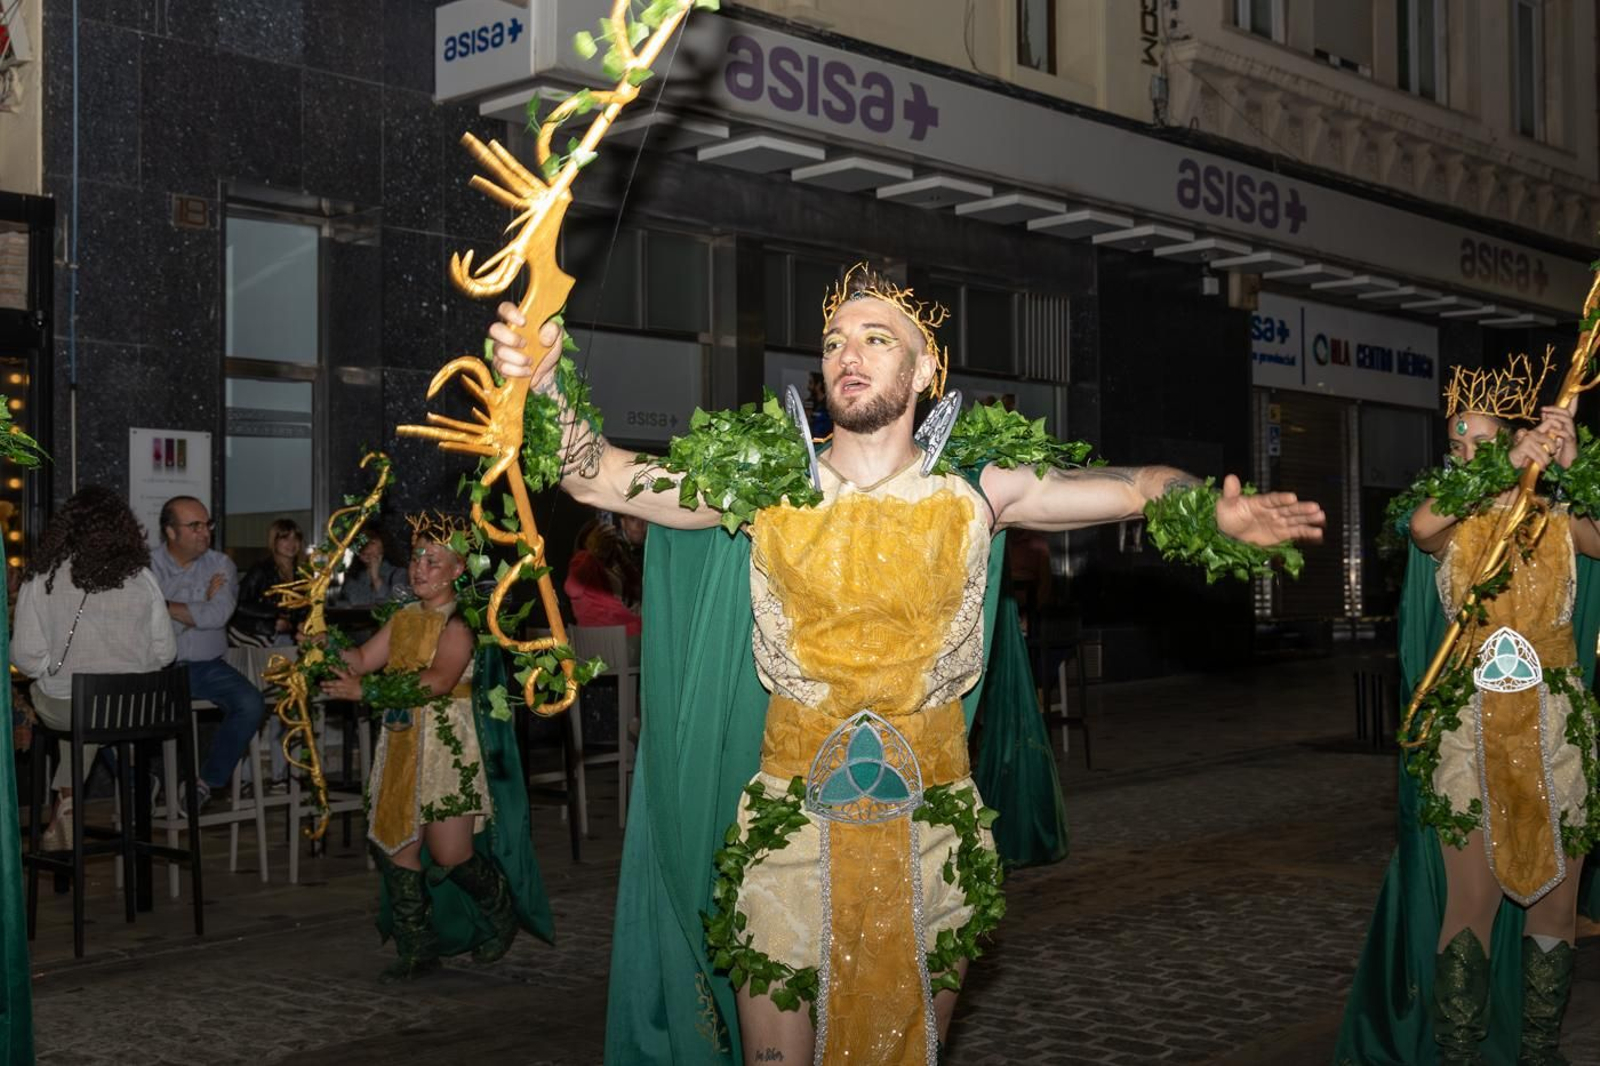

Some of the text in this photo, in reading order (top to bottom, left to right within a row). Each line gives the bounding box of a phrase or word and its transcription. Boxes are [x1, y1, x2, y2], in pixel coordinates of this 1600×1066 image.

[443, 21, 505, 62] asisa
[724, 35, 894, 134] asisa
[1177, 158, 1280, 230] asisa
[1461, 237, 1530, 294] asisa
[627, 410, 668, 427] asisa
